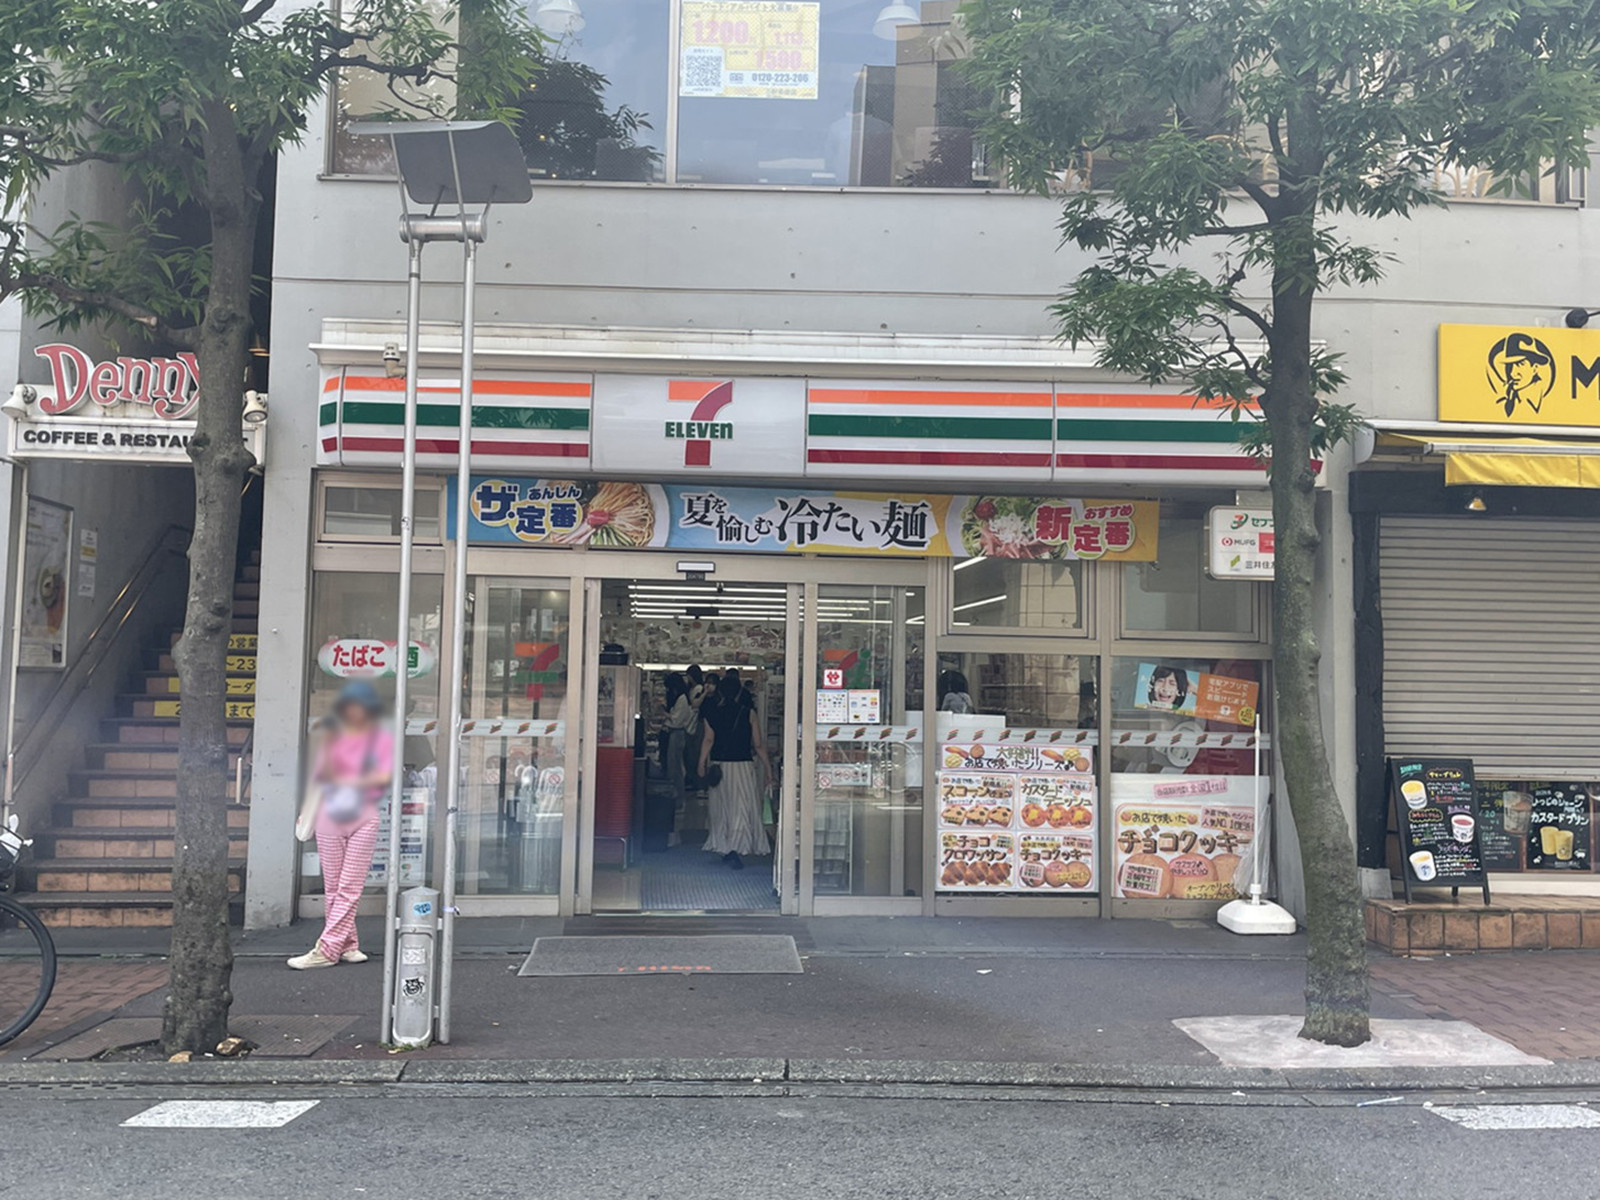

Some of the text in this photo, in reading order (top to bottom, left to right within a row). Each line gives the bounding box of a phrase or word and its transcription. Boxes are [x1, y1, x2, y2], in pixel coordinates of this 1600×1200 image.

[23, 430, 98, 445] COFFEE
[102, 432, 116, 446] &
[528, 485, 581, 501] あんしん
[1083, 505, 1133, 520] おすすめ
[1036, 504, 1131, 553] 新定番
[332, 644, 386, 668] たばこ
[943, 784, 990, 798] スコーン
[1131, 811, 1187, 824] お店で焼いた
[1531, 811, 1590, 826] カスタードプリン
[956, 834, 991, 848] チョコ
[943, 848, 1007, 863] クロワッサン
